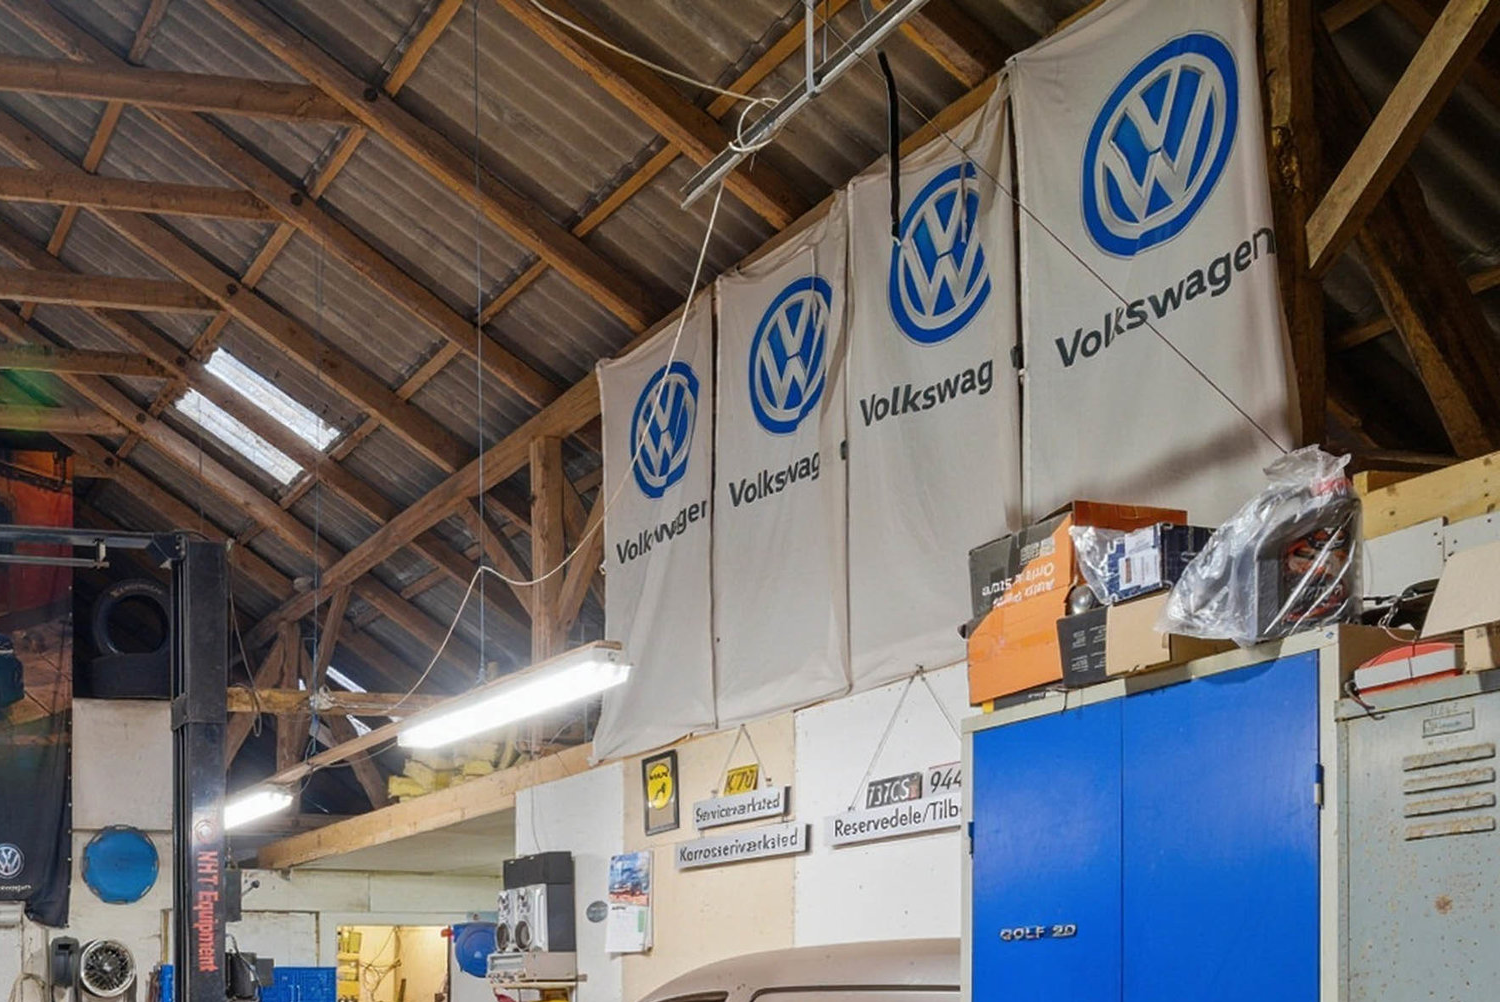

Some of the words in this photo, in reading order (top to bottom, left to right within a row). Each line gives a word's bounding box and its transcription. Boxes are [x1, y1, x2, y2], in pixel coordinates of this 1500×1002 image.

[1055, 227, 1277, 368] Volkswagen
[834, 797, 961, 838] Reservedele/Tilb
[196, 849, 219, 886] NHT
[192, 889, 220, 972] Equipment
[999, 924, 1045, 942] GOLF
